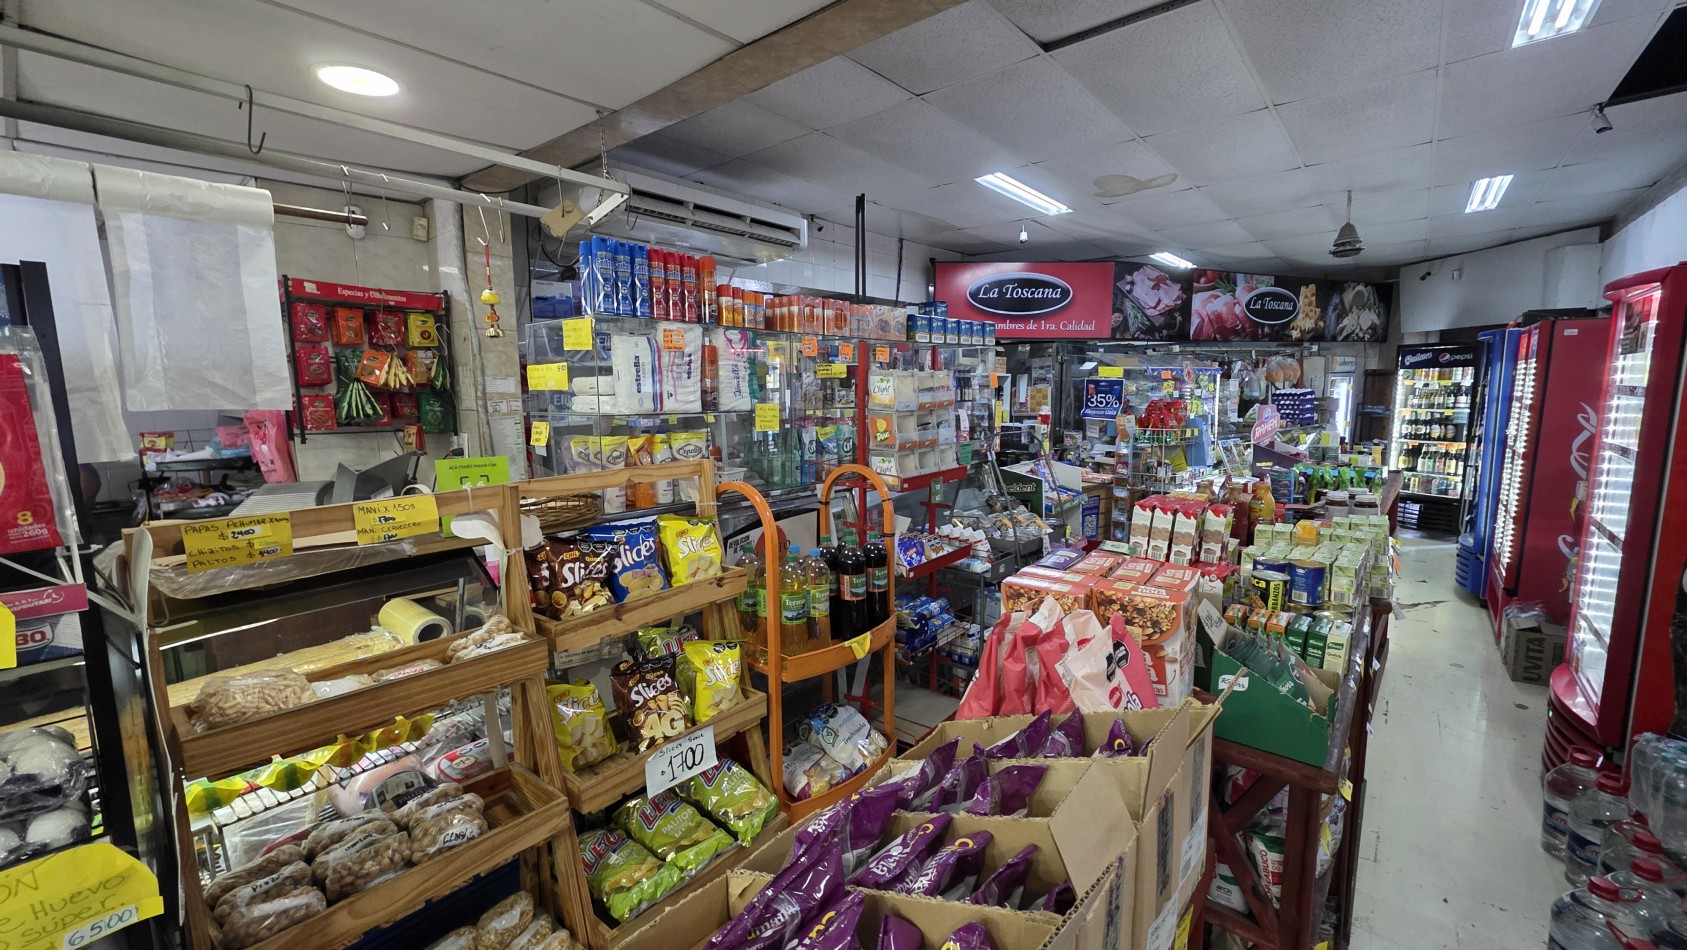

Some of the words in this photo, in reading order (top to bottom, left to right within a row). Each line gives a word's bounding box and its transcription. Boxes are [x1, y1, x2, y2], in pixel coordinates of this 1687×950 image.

[337, 286, 364, 297] Especias
[977, 284, 999, 298] La
[1002, 283, 1062, 299] Toscana
[1249, 296, 1262, 309] La
[1262, 296, 1294, 311] Toscana
[1026, 319, 1038, 331] de
[1059, 319, 1096, 331] Calidad
[633, 355, 641, 394] estrella
[1087, 393, 1120, 408] 35%
[1003, 482, 1037, 493] eldent
[16, 510, 34, 525] 8
[7, 523, 46, 534] unidades
[22, 528, 49, 538] 260g
[183, 523, 220, 535] PAPAS
[1270, 582, 1281, 615] ARBANZOS
[30, 874, 126, 921] Huevo
[67, 908, 134, 948] 6500
